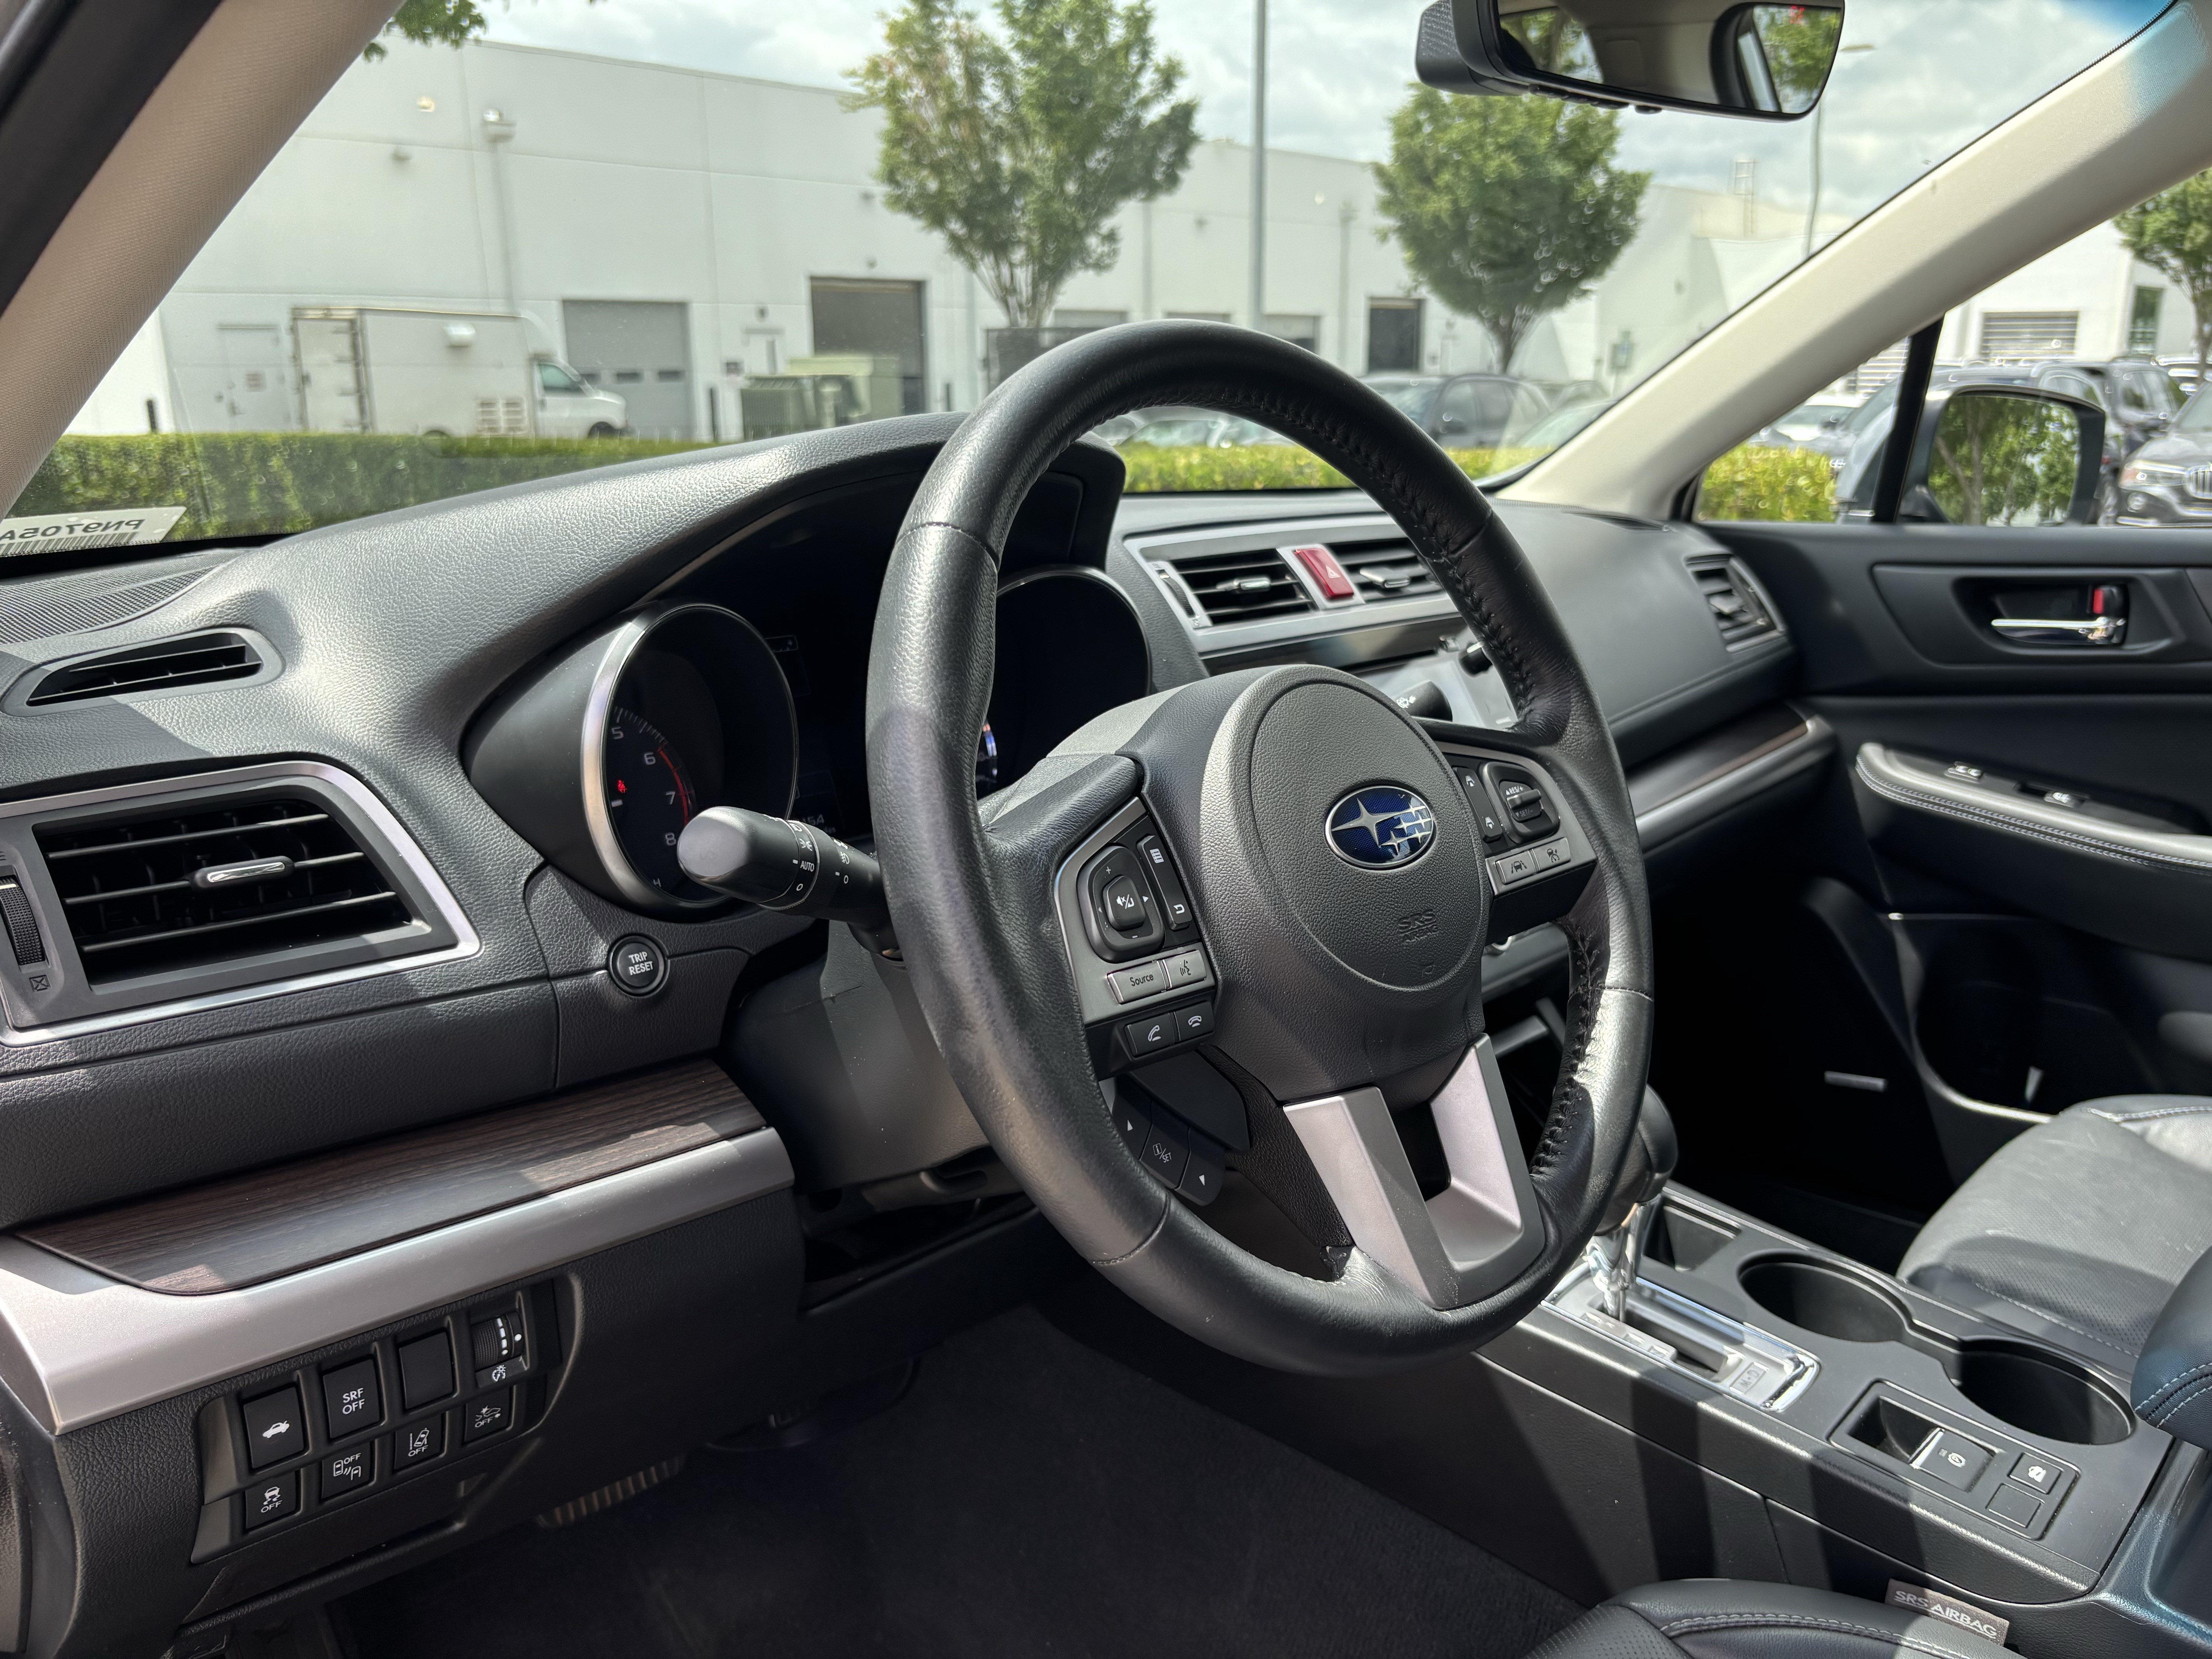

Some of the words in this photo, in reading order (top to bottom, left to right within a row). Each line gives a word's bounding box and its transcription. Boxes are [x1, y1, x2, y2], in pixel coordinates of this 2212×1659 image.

[611, 726, 624, 740] 5
[644, 752, 656, 765] 6
[665, 791, 675, 805] 7
[665, 832, 677, 846] 8
[800, 860, 815, 872] AUTO
[1397, 910, 1436, 932] SRS
[628, 951, 647, 964] TRIP
[629, 961, 653, 976] RESET
[1130, 974, 1154, 986] Source
[342, 1387, 364, 1403] SRF
[342, 1398, 365, 1415] OFF
[474, 1416, 494, 1428] OFF
[408, 1445, 428, 1457] OFF
[343, 1452, 362, 1464] OFF
[261, 1500, 283, 1513] OFF
[1894, 1590, 1929, 1607] SRS
[1930, 1604, 1997, 1637] AIRBAG
